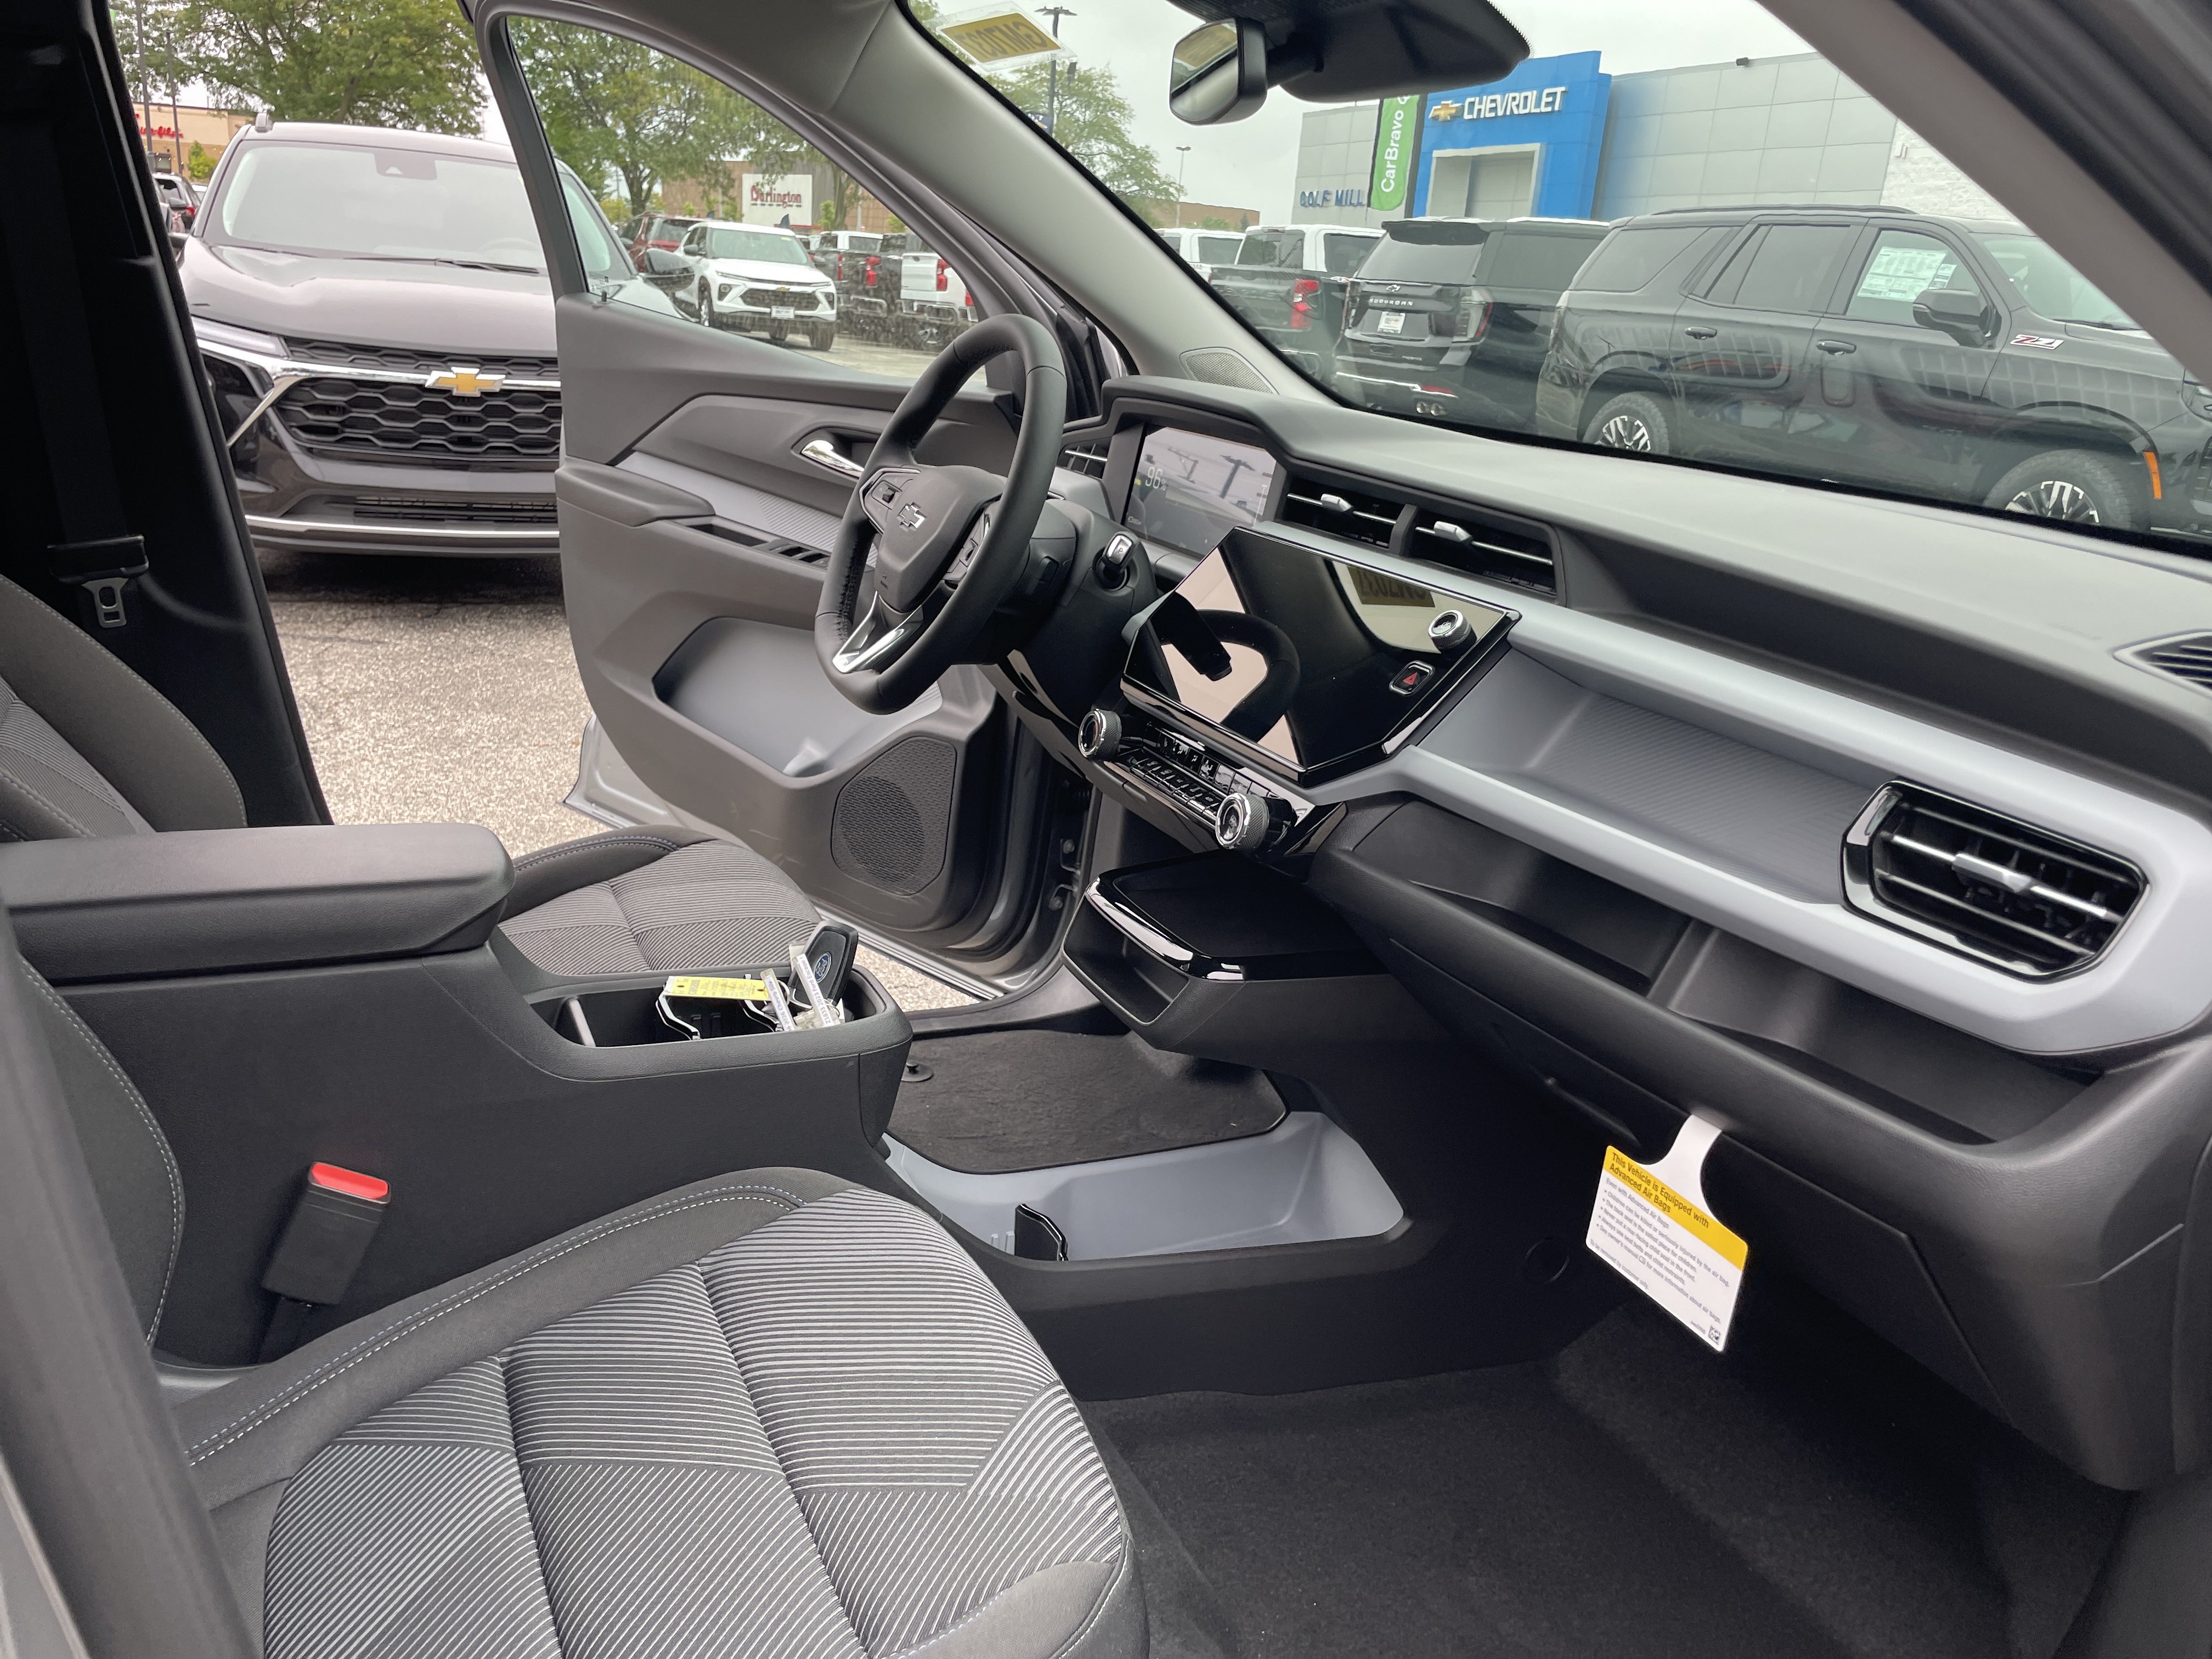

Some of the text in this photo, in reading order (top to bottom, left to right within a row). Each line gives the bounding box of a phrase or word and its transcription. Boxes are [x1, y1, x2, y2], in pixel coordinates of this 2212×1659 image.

[1463, 86, 1567, 120] CHEVROLET
[1380, 109, 1404, 193] CarBravo
[750, 185, 803, 208] Burlington
[1300, 189, 1365, 207] GOLF MILL
[800, 959, 812, 979] Escape
[809, 979, 817, 991] Ford
[1609, 1162, 1671, 1215] Advanced Air Bags
[1611, 1152, 1709, 1229] This Vehicle is Equipped with
[1657, 1215, 1669, 1230] Bags
